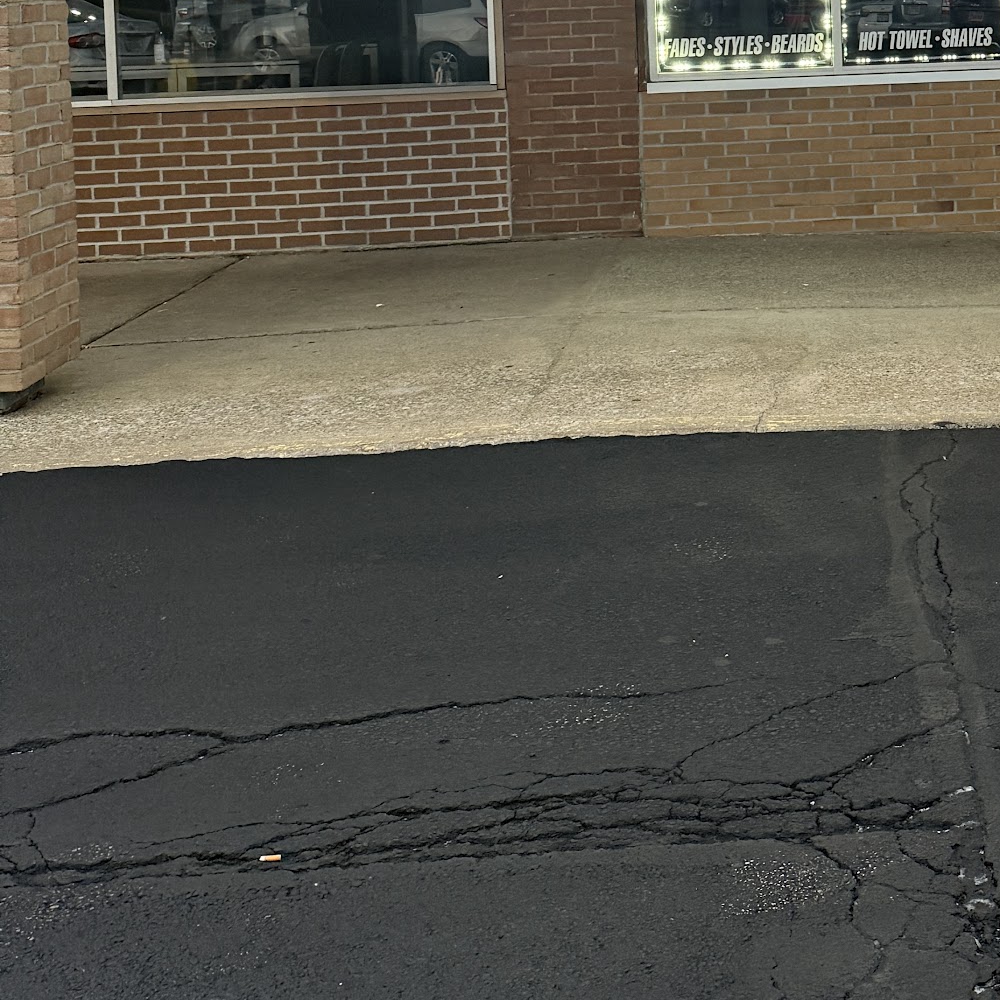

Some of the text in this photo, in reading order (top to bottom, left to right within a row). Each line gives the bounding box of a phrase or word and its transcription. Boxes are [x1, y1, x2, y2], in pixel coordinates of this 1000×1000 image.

[665, 32, 825, 58] FADES STYLES BEARDS
[858, 26, 994, 51] HOT TOWEL SHAVES
